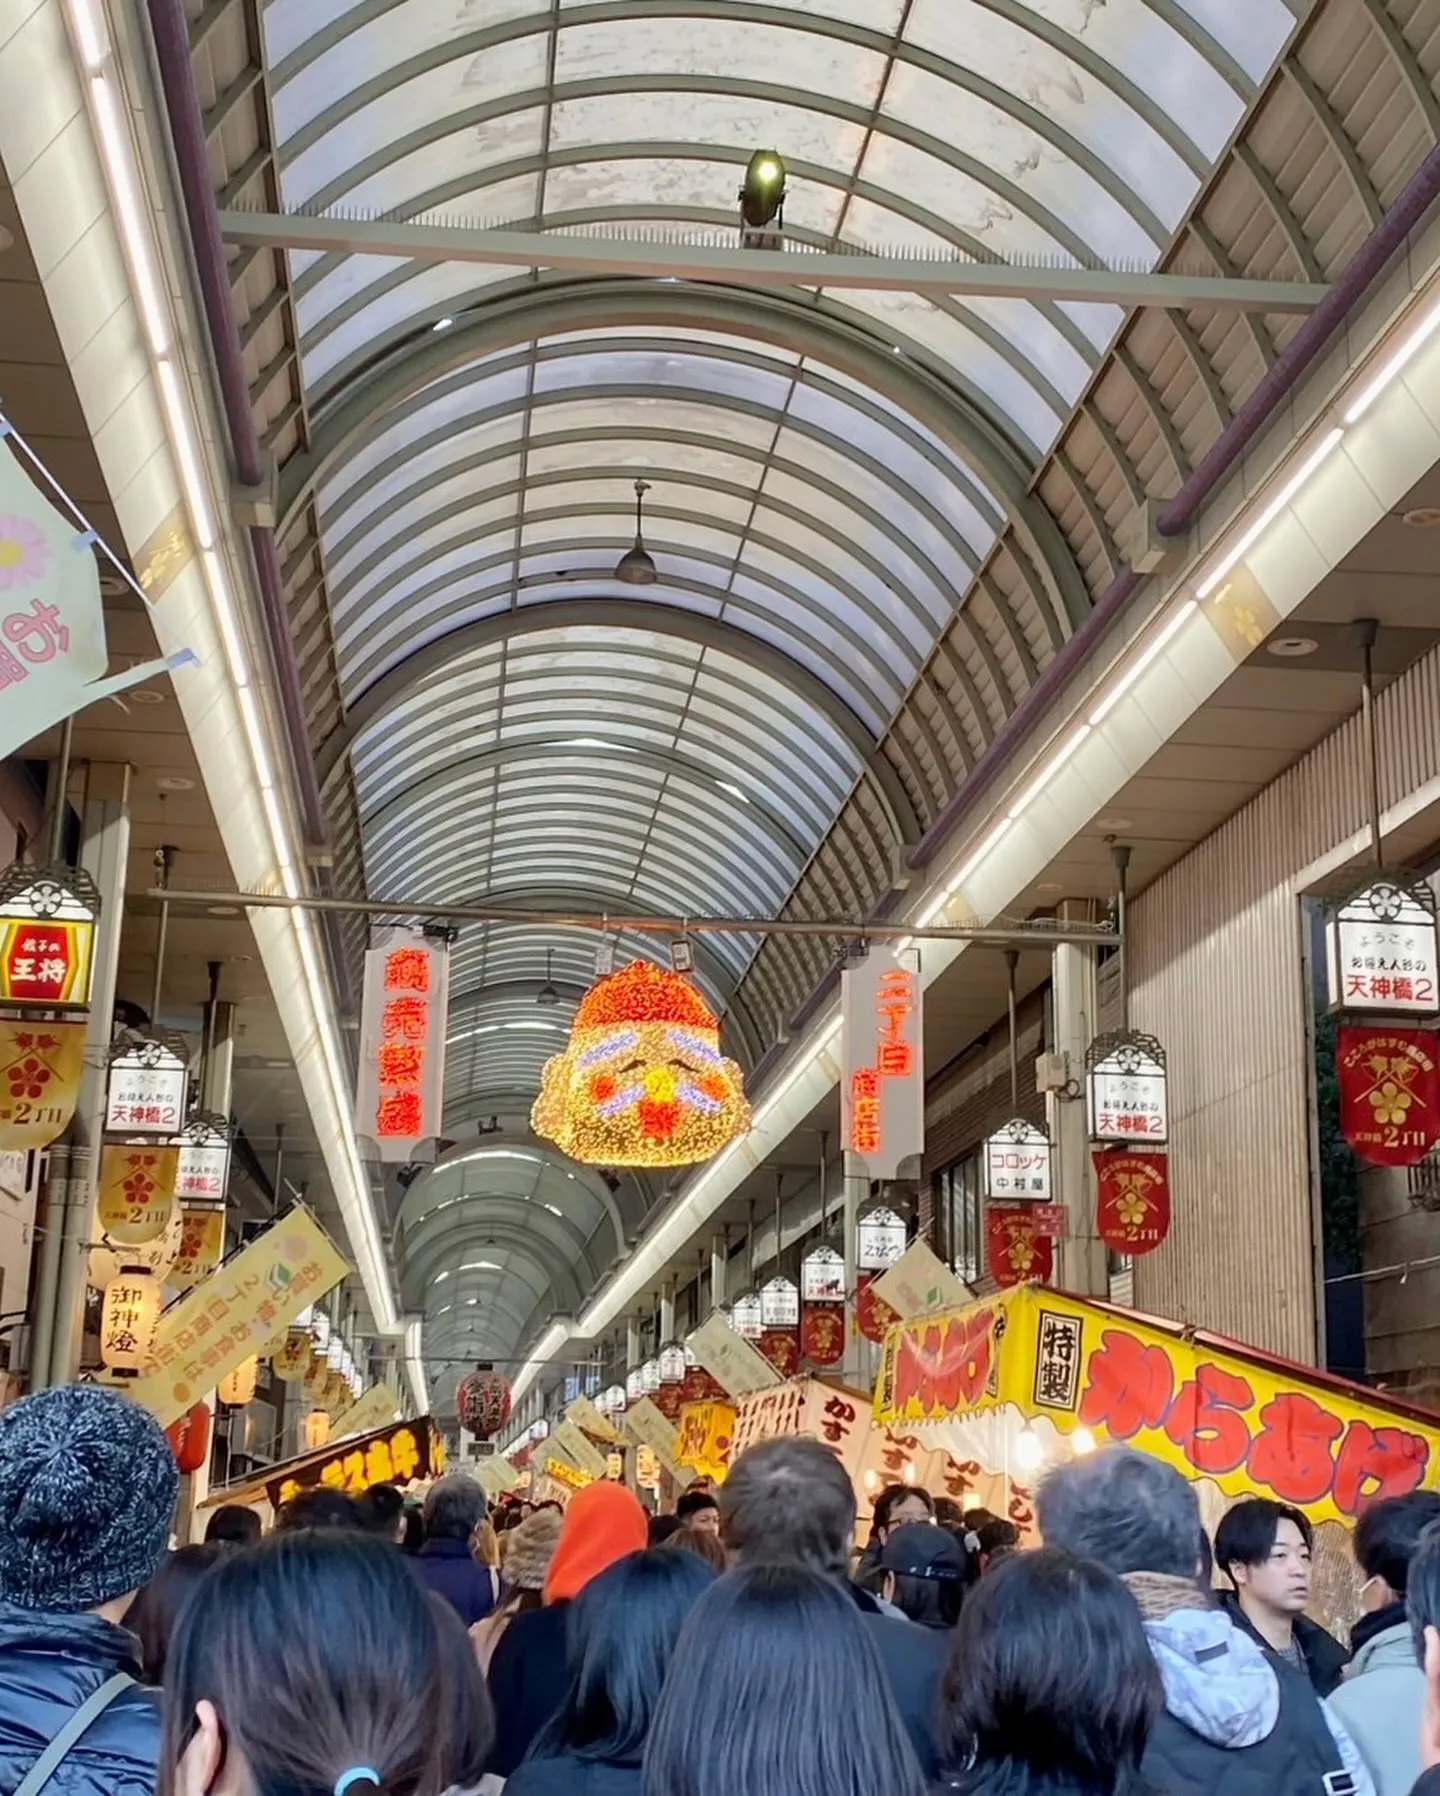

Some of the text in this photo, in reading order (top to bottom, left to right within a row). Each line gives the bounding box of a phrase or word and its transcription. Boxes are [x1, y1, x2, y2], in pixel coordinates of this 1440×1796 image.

[21, 938, 61, 952] 餃子の
[1360, 932, 1415, 950] ようこそ
[10, 958, 67, 983] 王将
[1352, 956, 1426, 972] お迎え人形の
[1346, 974, 1434, 1002] 天神橋2
[112, 1104, 175, 1124] 天神橋2
[1100, 1114, 1163, 1133] 天神橋2
[992, 1153, 1047, 1170] コロッケ
[105, 1288, 142, 1354] 御神燈
[1041, 1321, 1076, 1402] 特製
[1078, 1327, 1430, 1520] からあげ
